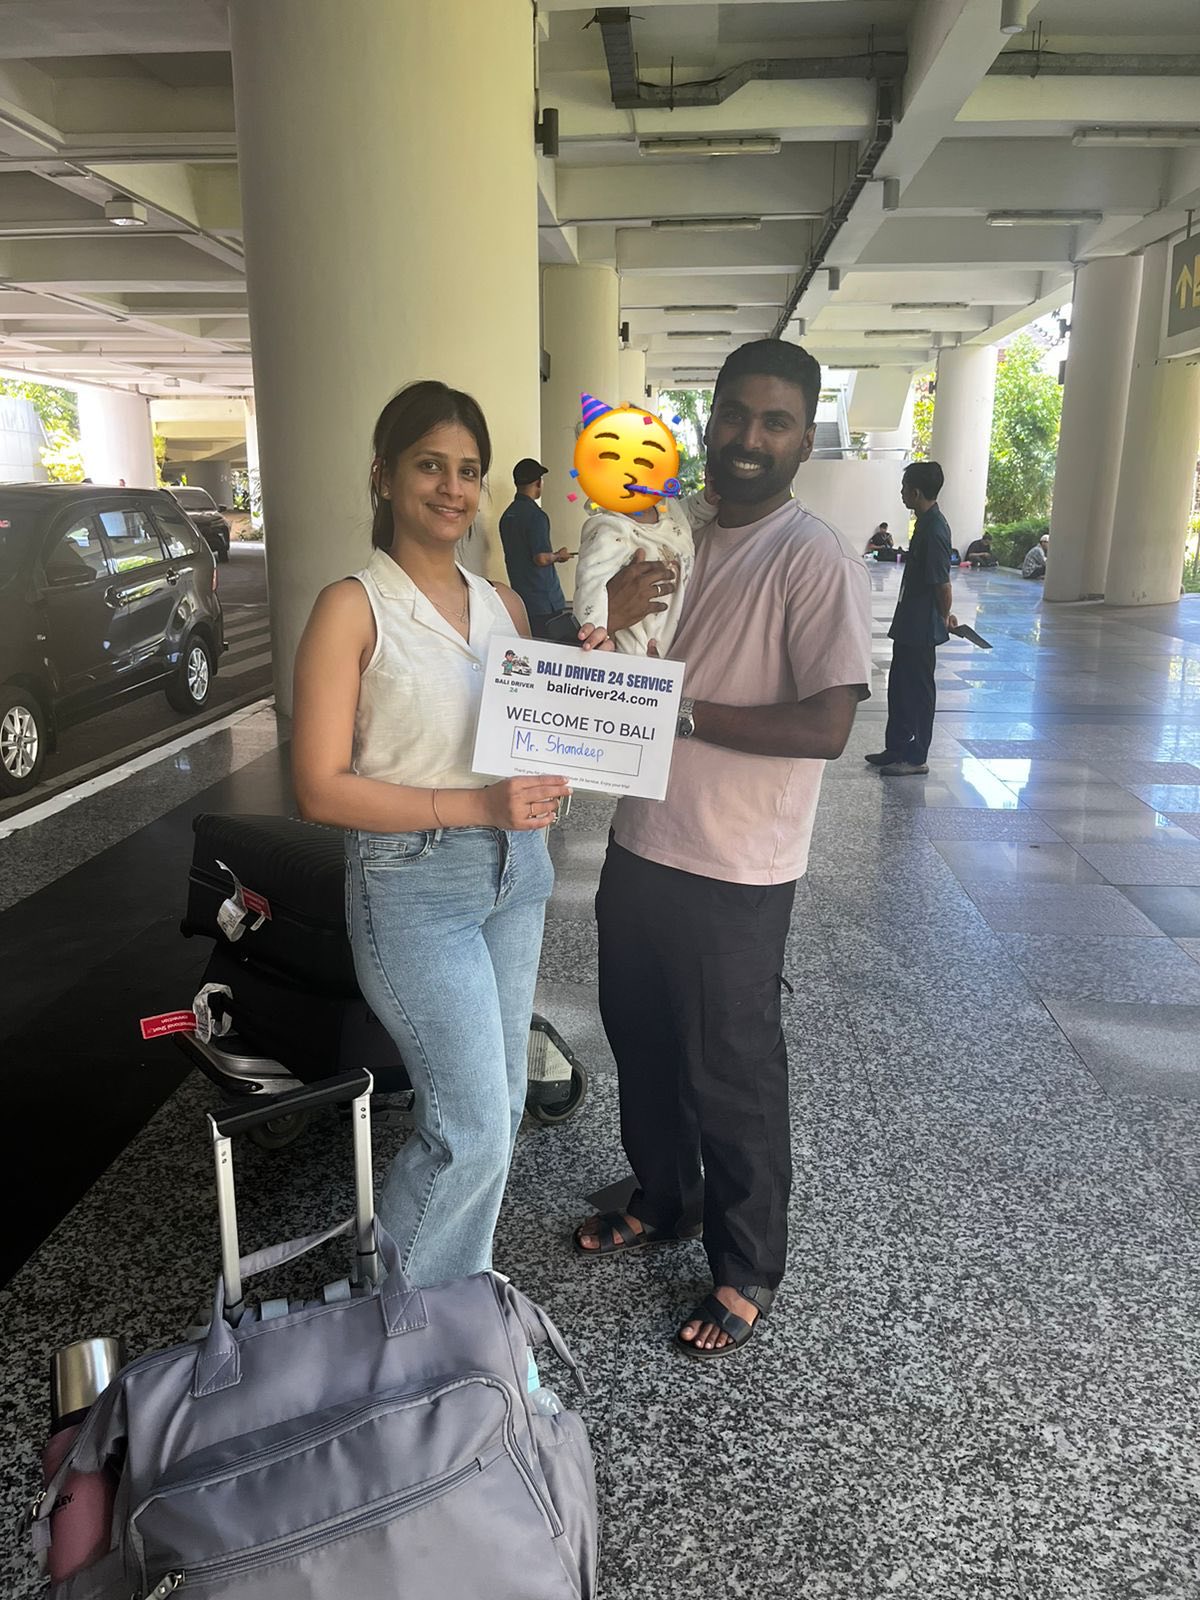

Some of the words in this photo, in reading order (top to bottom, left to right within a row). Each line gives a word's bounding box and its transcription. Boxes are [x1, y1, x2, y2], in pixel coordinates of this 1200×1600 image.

[510, 680, 535, 689] DRIVER
[537, 660, 562, 677] BALI
[565, 664, 606, 683] DRIVER
[608, 671, 624, 686] 24
[626, 673, 674, 693] SERVICE
[547, 680, 658, 707] balidriver24.com
[506, 705, 589, 731] WELCOME
[593, 718, 615, 735] TO
[620, 723, 655, 740] BALI
[516, 730, 538, 752] Mr.
[545, 734, 605, 762] Shandeep
